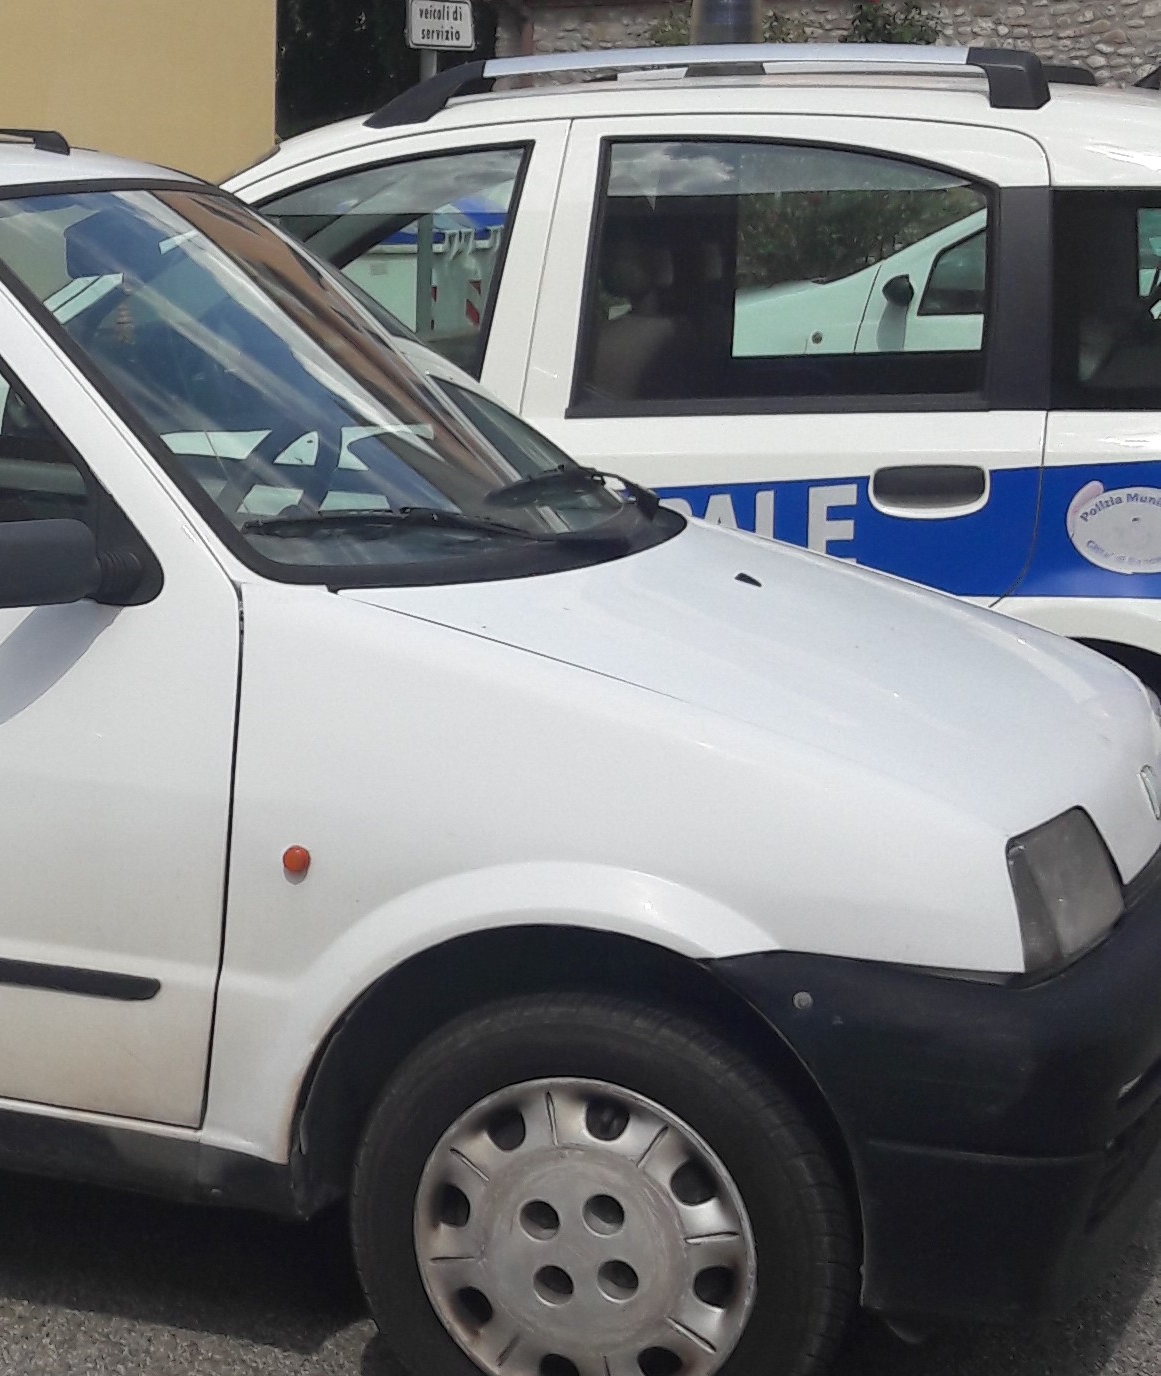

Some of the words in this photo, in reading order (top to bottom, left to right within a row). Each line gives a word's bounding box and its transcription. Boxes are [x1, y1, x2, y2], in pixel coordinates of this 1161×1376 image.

[419, 4, 450, 21] veicoli
[452, 5, 463, 22] di
[421, 24, 461, 42] servizio
[1079, 496, 1123, 523] Polizia
